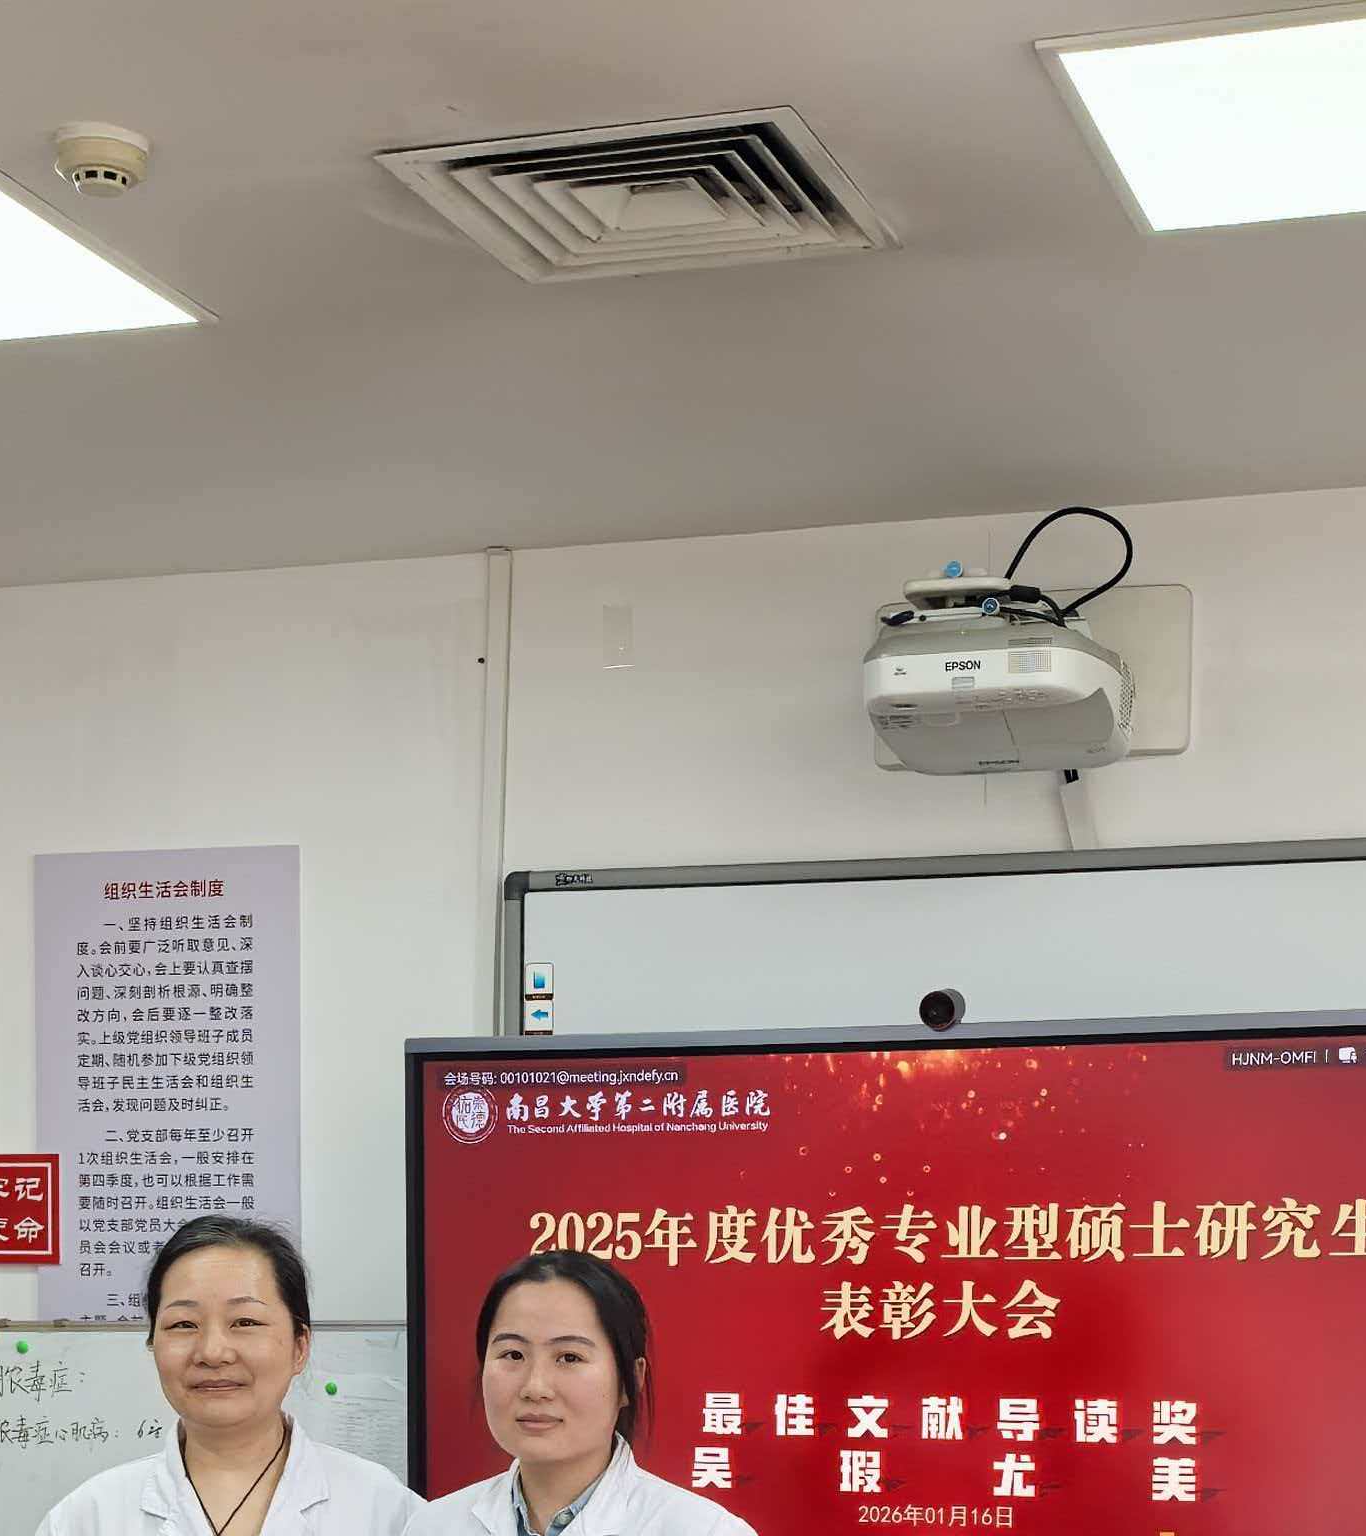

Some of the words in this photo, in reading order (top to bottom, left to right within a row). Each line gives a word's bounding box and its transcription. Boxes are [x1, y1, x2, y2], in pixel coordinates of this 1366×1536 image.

[945, 659, 981, 672] EPSON
[102, 878, 228, 904] 组织生活会制度
[103, 913, 254, 932] 一、坚持组织生活会制
[76, 936, 254, 960] 度。会前要广泛听取意见、深
[76, 982, 254, 1001] 问题、深刻剖析根源、明确整
[75, 1027, 254, 1049] 实。上级党组织领导班子成员
[75, 1050, 254, 1071] 定期、随机参加下级党组织领
[77, 1072, 255, 1091] 导班子民主生活会和组织生
[500, 1070, 678, 1085] 00101021@meeting.jxndefy.cn
[506, 1090, 771, 1121] 南昌大学第二附属医院
[104, 1127, 254, 1145] 二、党支部每年至少召开
[508, 1125, 525, 1134] The
[527, 1124, 565, 1134] Second
[567, 1123, 610, 1133] Affiliated
[613, 1123, 651, 1134] Hospital
[654, 1123, 664, 1132] of
[667, 1122, 716, 1134] Nanchang
[719, 1121, 768, 1133] University
[77, 1195, 256, 1211] 要随时召开。组织生活会一般
[78, 1262, 112, 1278] 召开。
[820, 1279, 1060, 1341] 表彰大会
[702, 1392, 1197, 1446] 最佳文献导读奖
[857, 1504, 1014, 1528] 2026年01月16日
